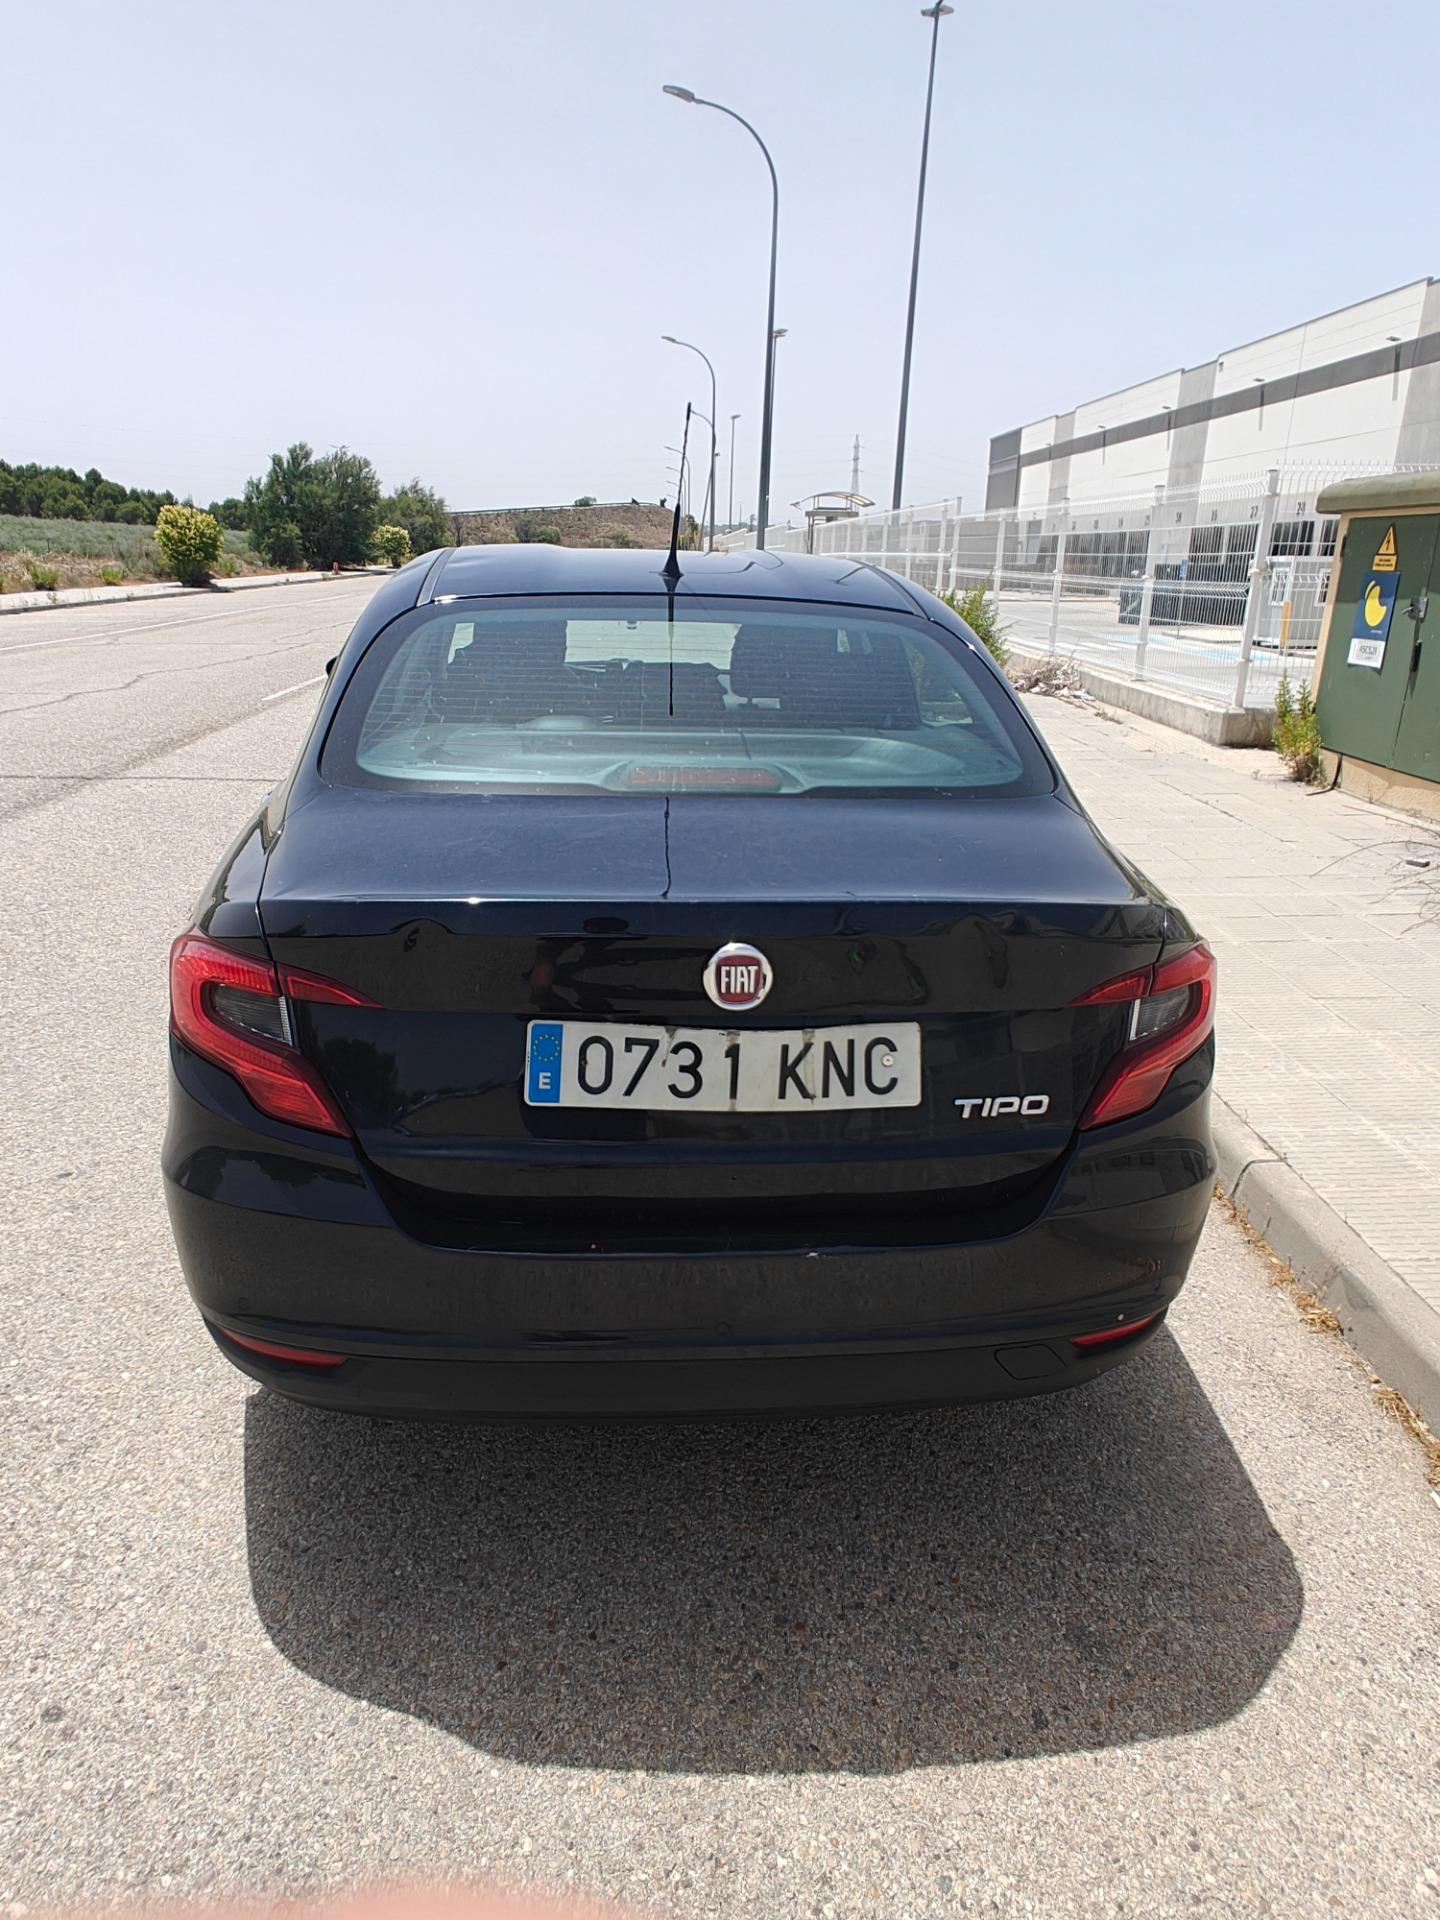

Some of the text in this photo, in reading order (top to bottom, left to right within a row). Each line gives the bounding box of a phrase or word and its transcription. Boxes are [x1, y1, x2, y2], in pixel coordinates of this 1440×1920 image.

[720, 965, 759, 994] FIAT
[538, 1071, 552, 1090] E
[577, 1035, 899, 1100] 0731 KNC
[954, 1094, 1050, 1119] TIPO
